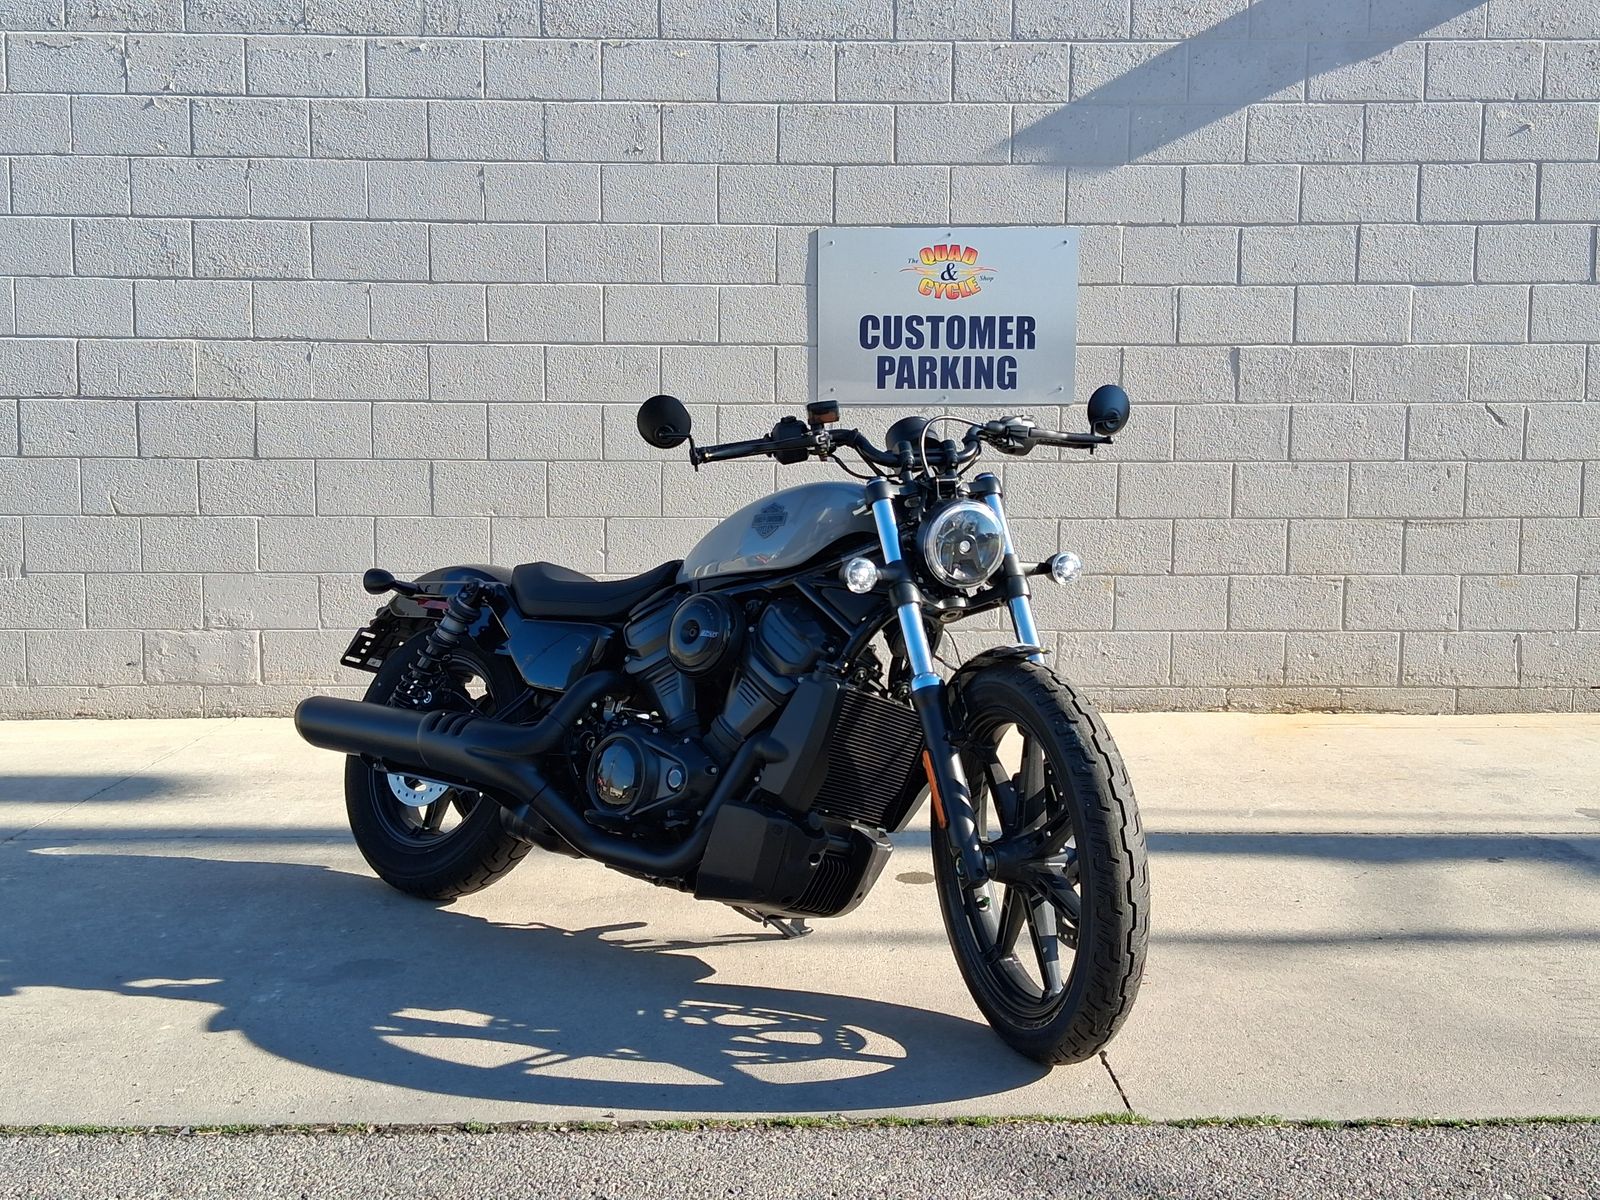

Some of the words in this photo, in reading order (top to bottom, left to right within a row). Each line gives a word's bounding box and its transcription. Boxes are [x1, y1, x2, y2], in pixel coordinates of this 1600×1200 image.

[919, 244, 978, 265] QUAD
[940, 262, 959, 281] &
[918, 276, 981, 300] CYCLE
[859, 314, 1036, 350] CUSTOMER
[876, 355, 1018, 390] PARKING
